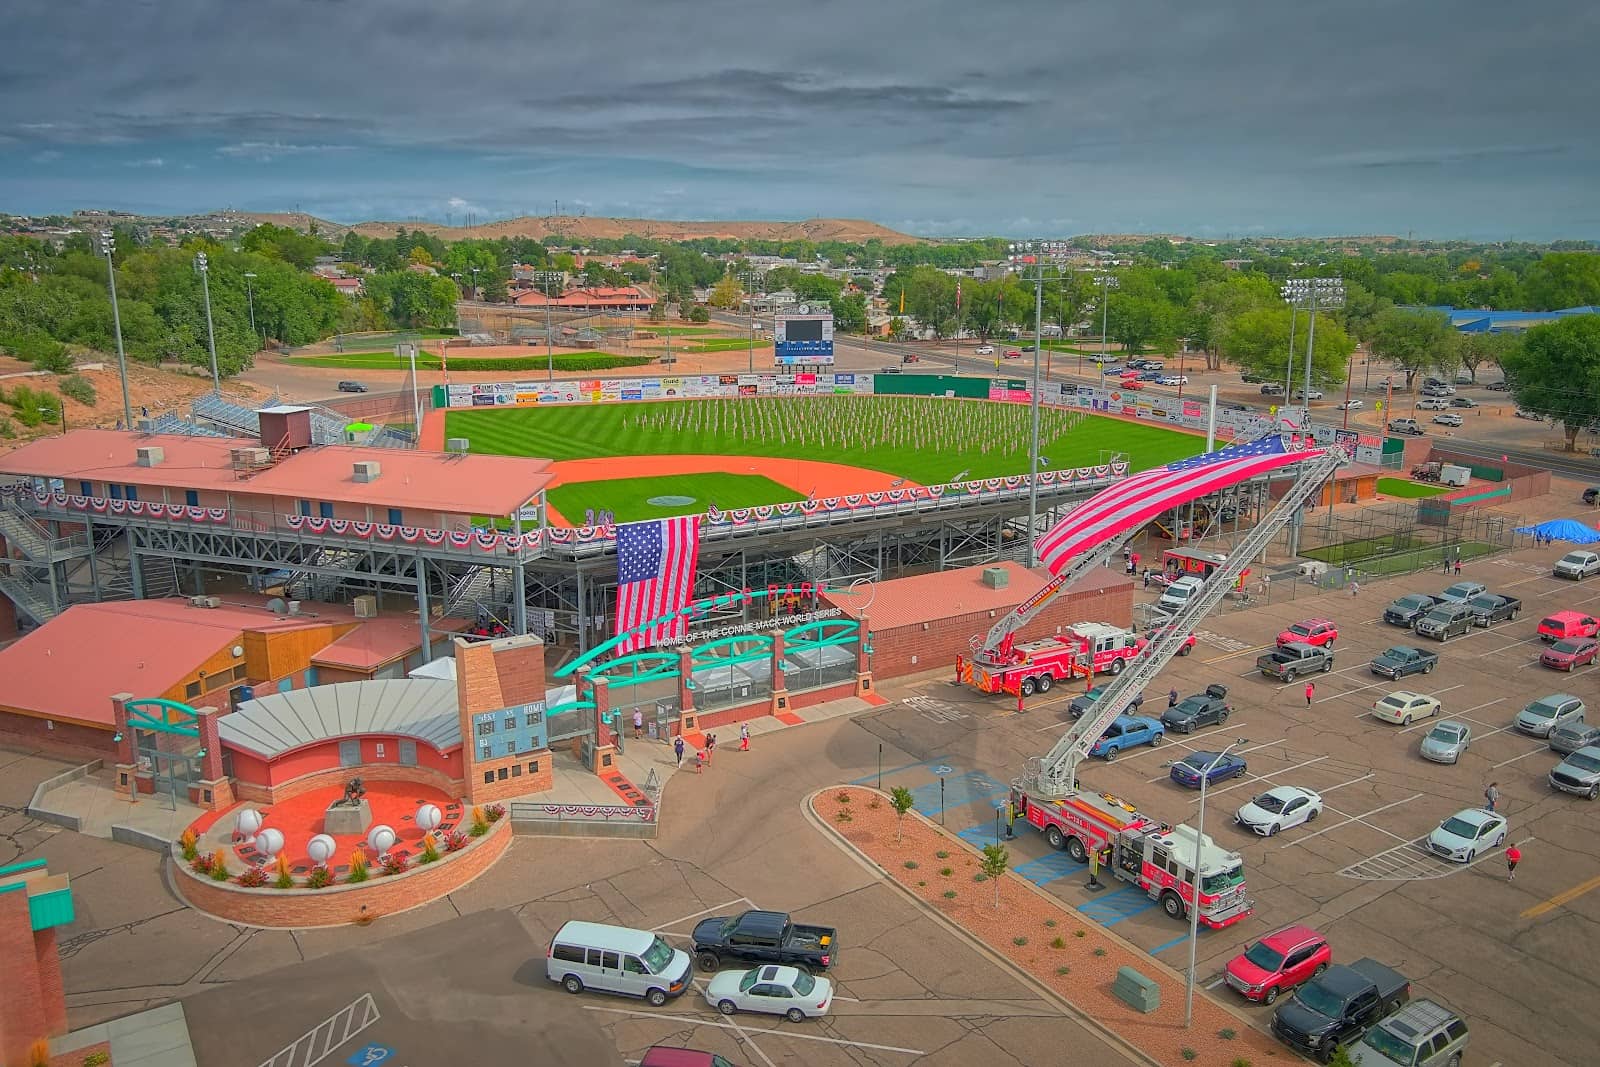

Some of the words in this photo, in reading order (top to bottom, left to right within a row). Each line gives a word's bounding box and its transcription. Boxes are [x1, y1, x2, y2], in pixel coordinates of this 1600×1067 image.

[768, 581, 827, 601] PARK
[656, 637, 683, 648] HOME
[686, 632, 698, 642] OF
[700, 628, 719, 639] THE
[721, 622, 754, 636] CONNIE
[756, 618, 781, 630] MACK
[783, 612, 812, 625] WORLD
[814, 607, 842, 619] SERIES
[523, 702, 543, 714] HOME
